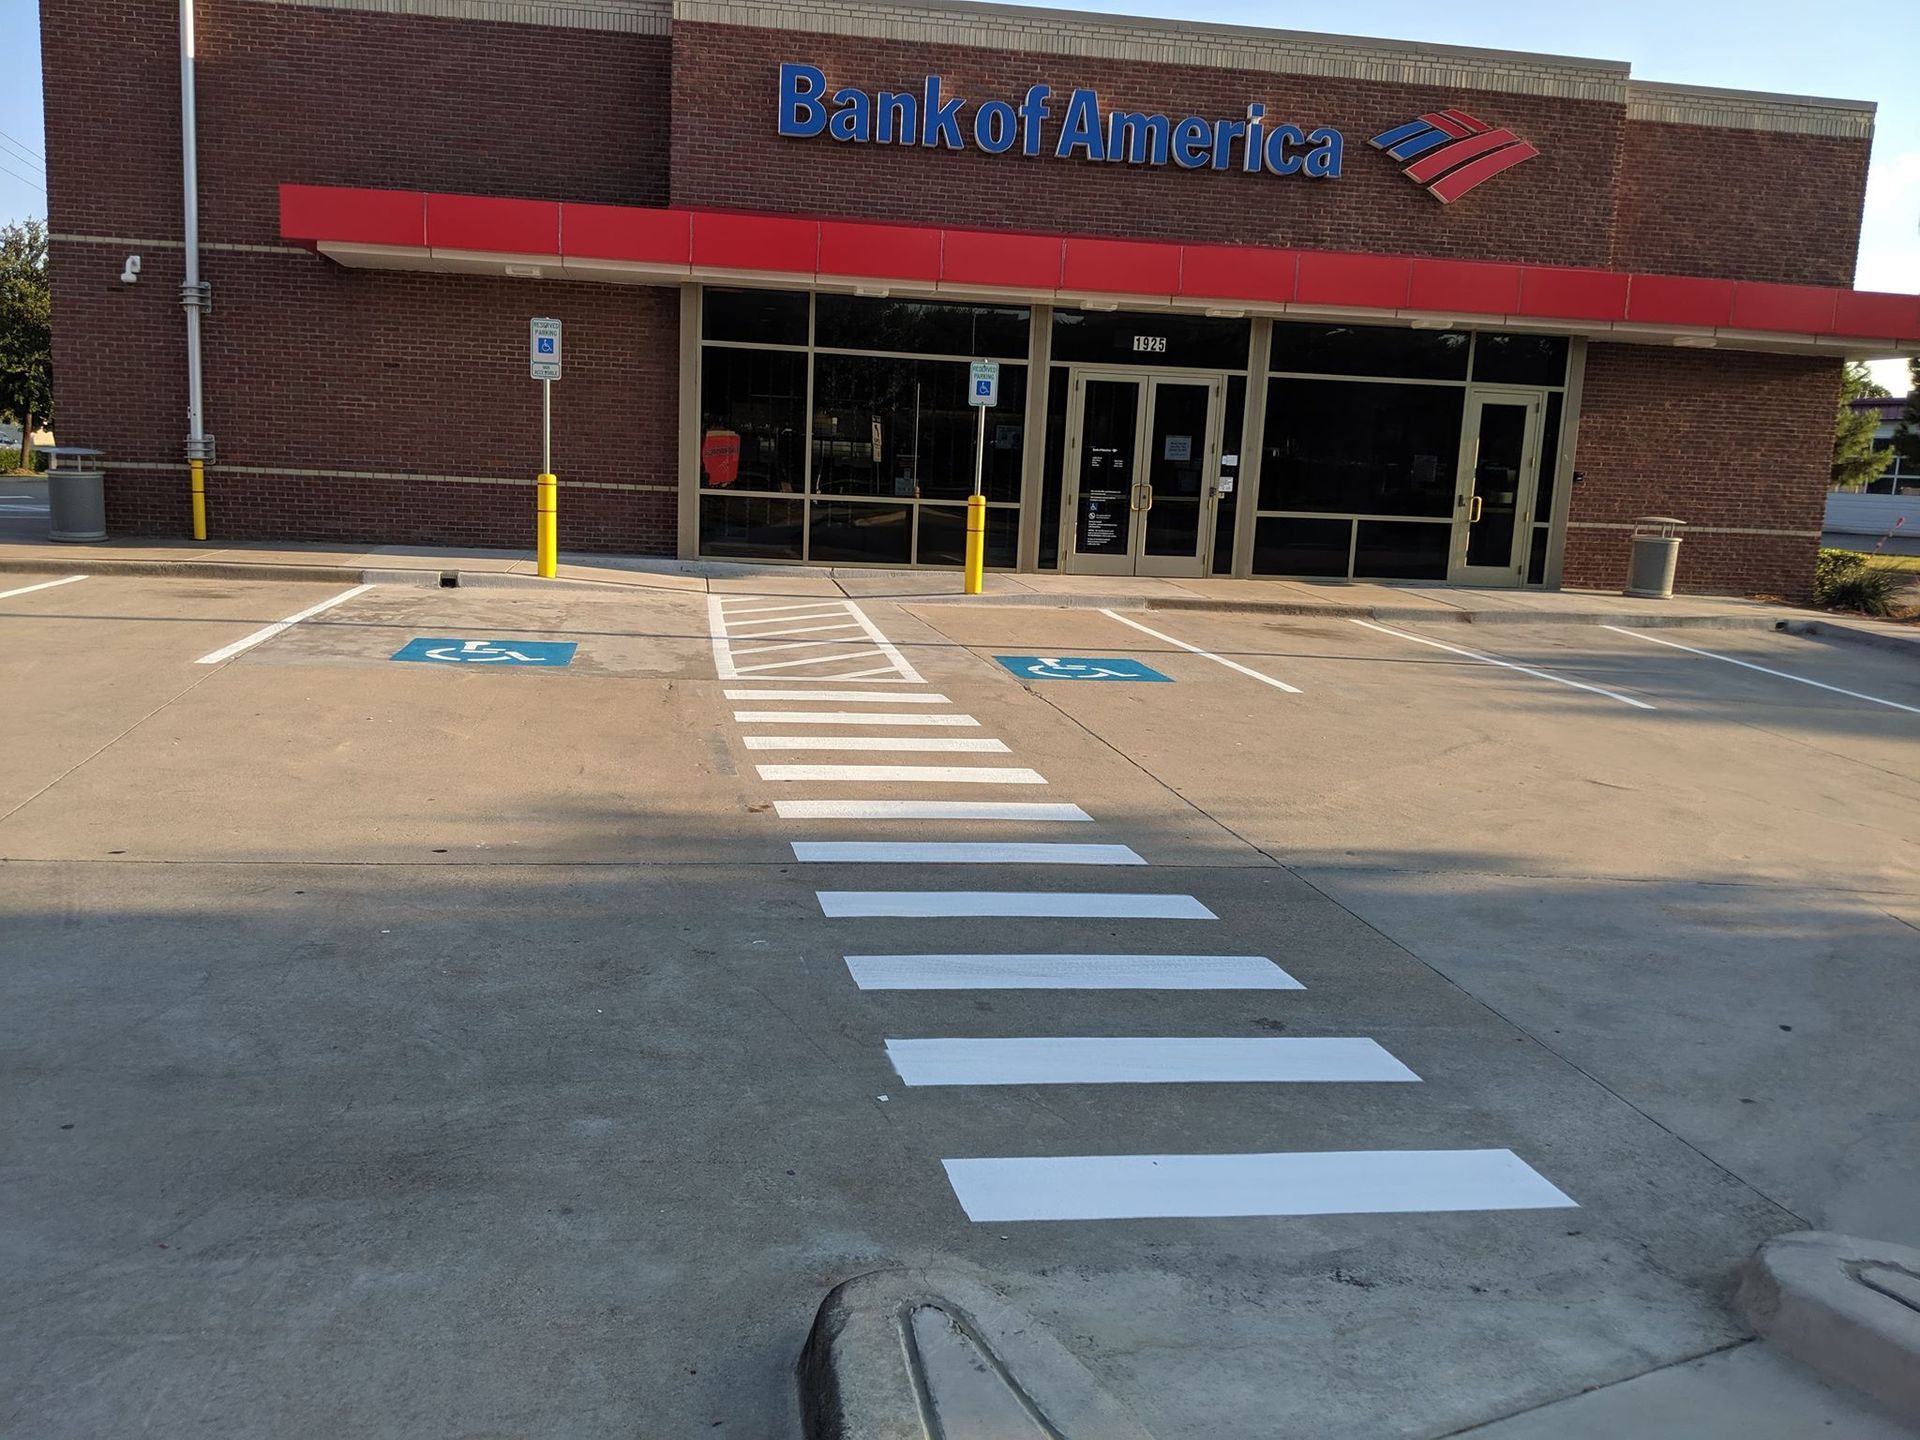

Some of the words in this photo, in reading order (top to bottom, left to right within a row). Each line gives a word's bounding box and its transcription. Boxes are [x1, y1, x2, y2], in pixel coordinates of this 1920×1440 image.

[777, 62, 966, 150] Bank
[975, 84, 1051, 156] of
[1055, 88, 1343, 179] America
[1135, 336, 1165, 351] 1925
